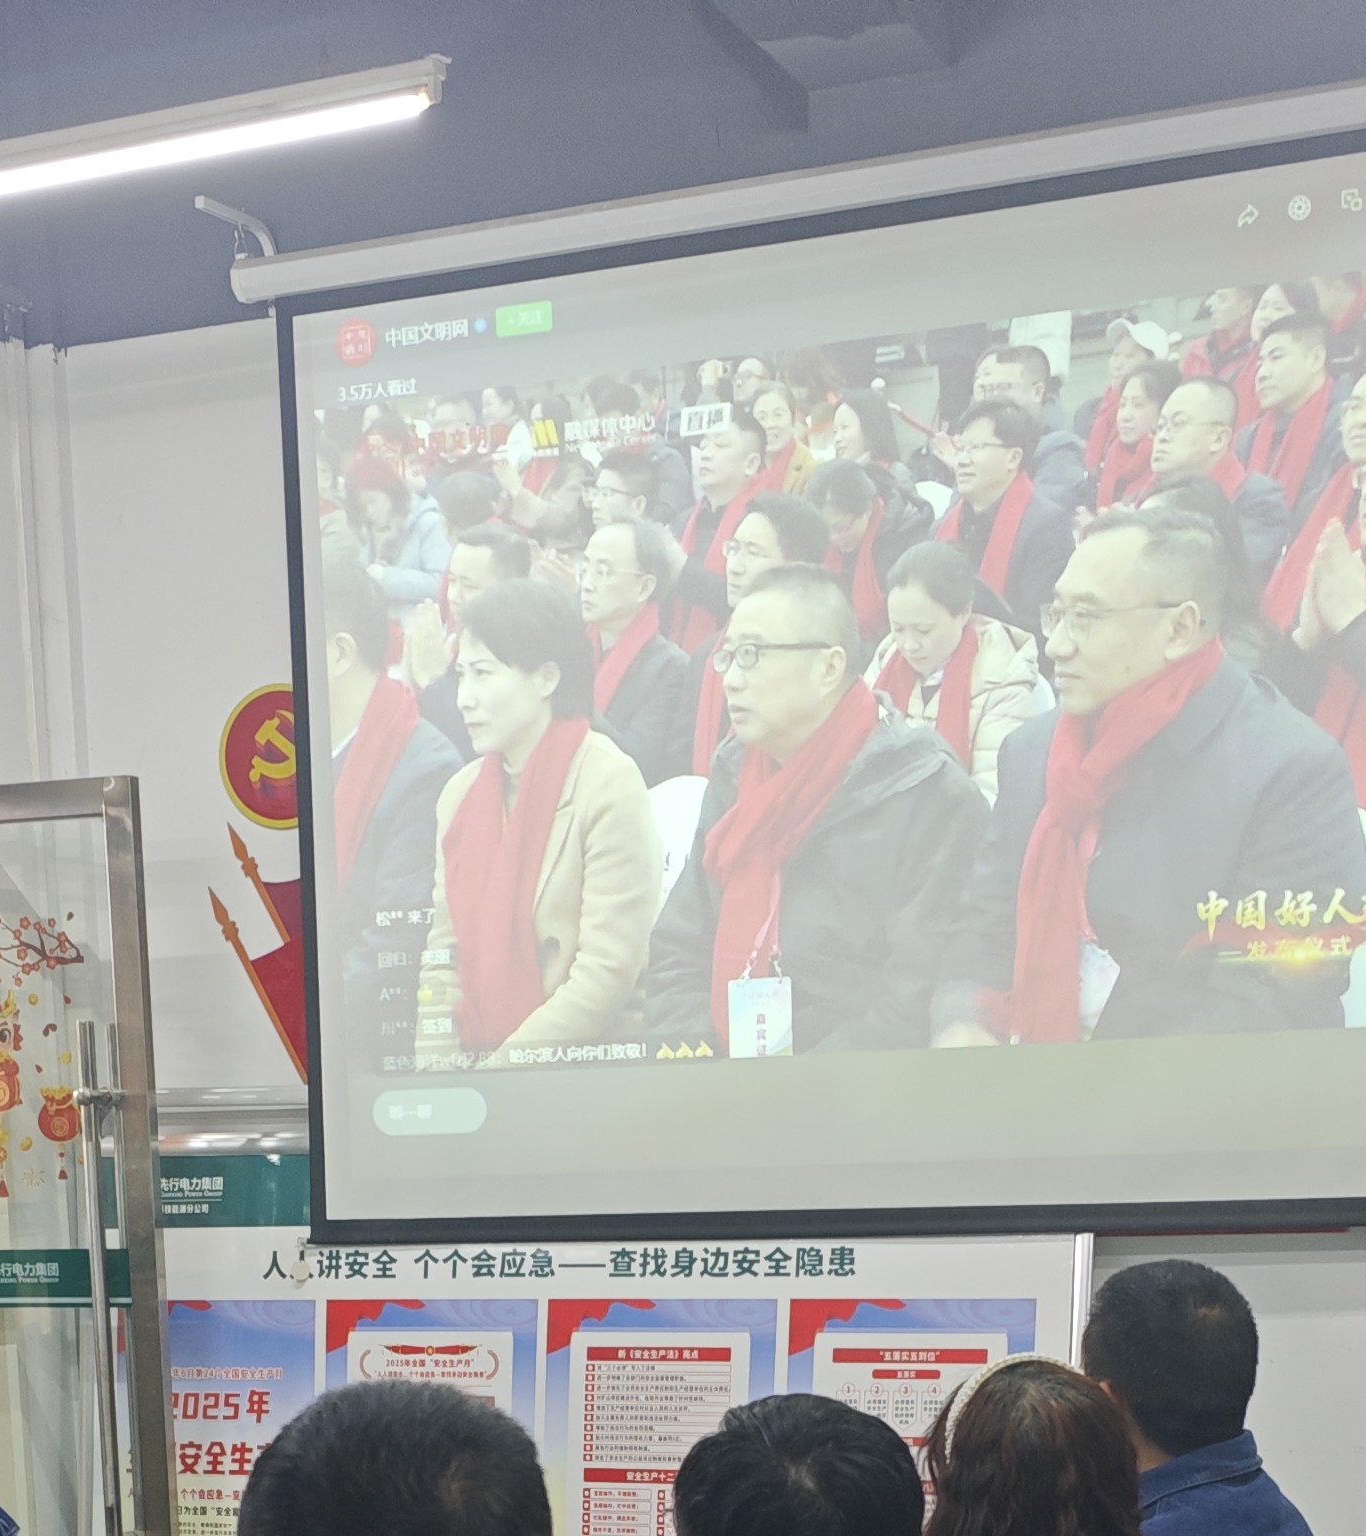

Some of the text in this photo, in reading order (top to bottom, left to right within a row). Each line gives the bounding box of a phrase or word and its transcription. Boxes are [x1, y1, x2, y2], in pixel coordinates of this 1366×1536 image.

[385, 319, 469, 348] 中国文明网
[338, 378, 418, 402] 3.5万人看过
[407, 908, 435, 924] 来了
[178, 1441, 271, 1475] 安全生
